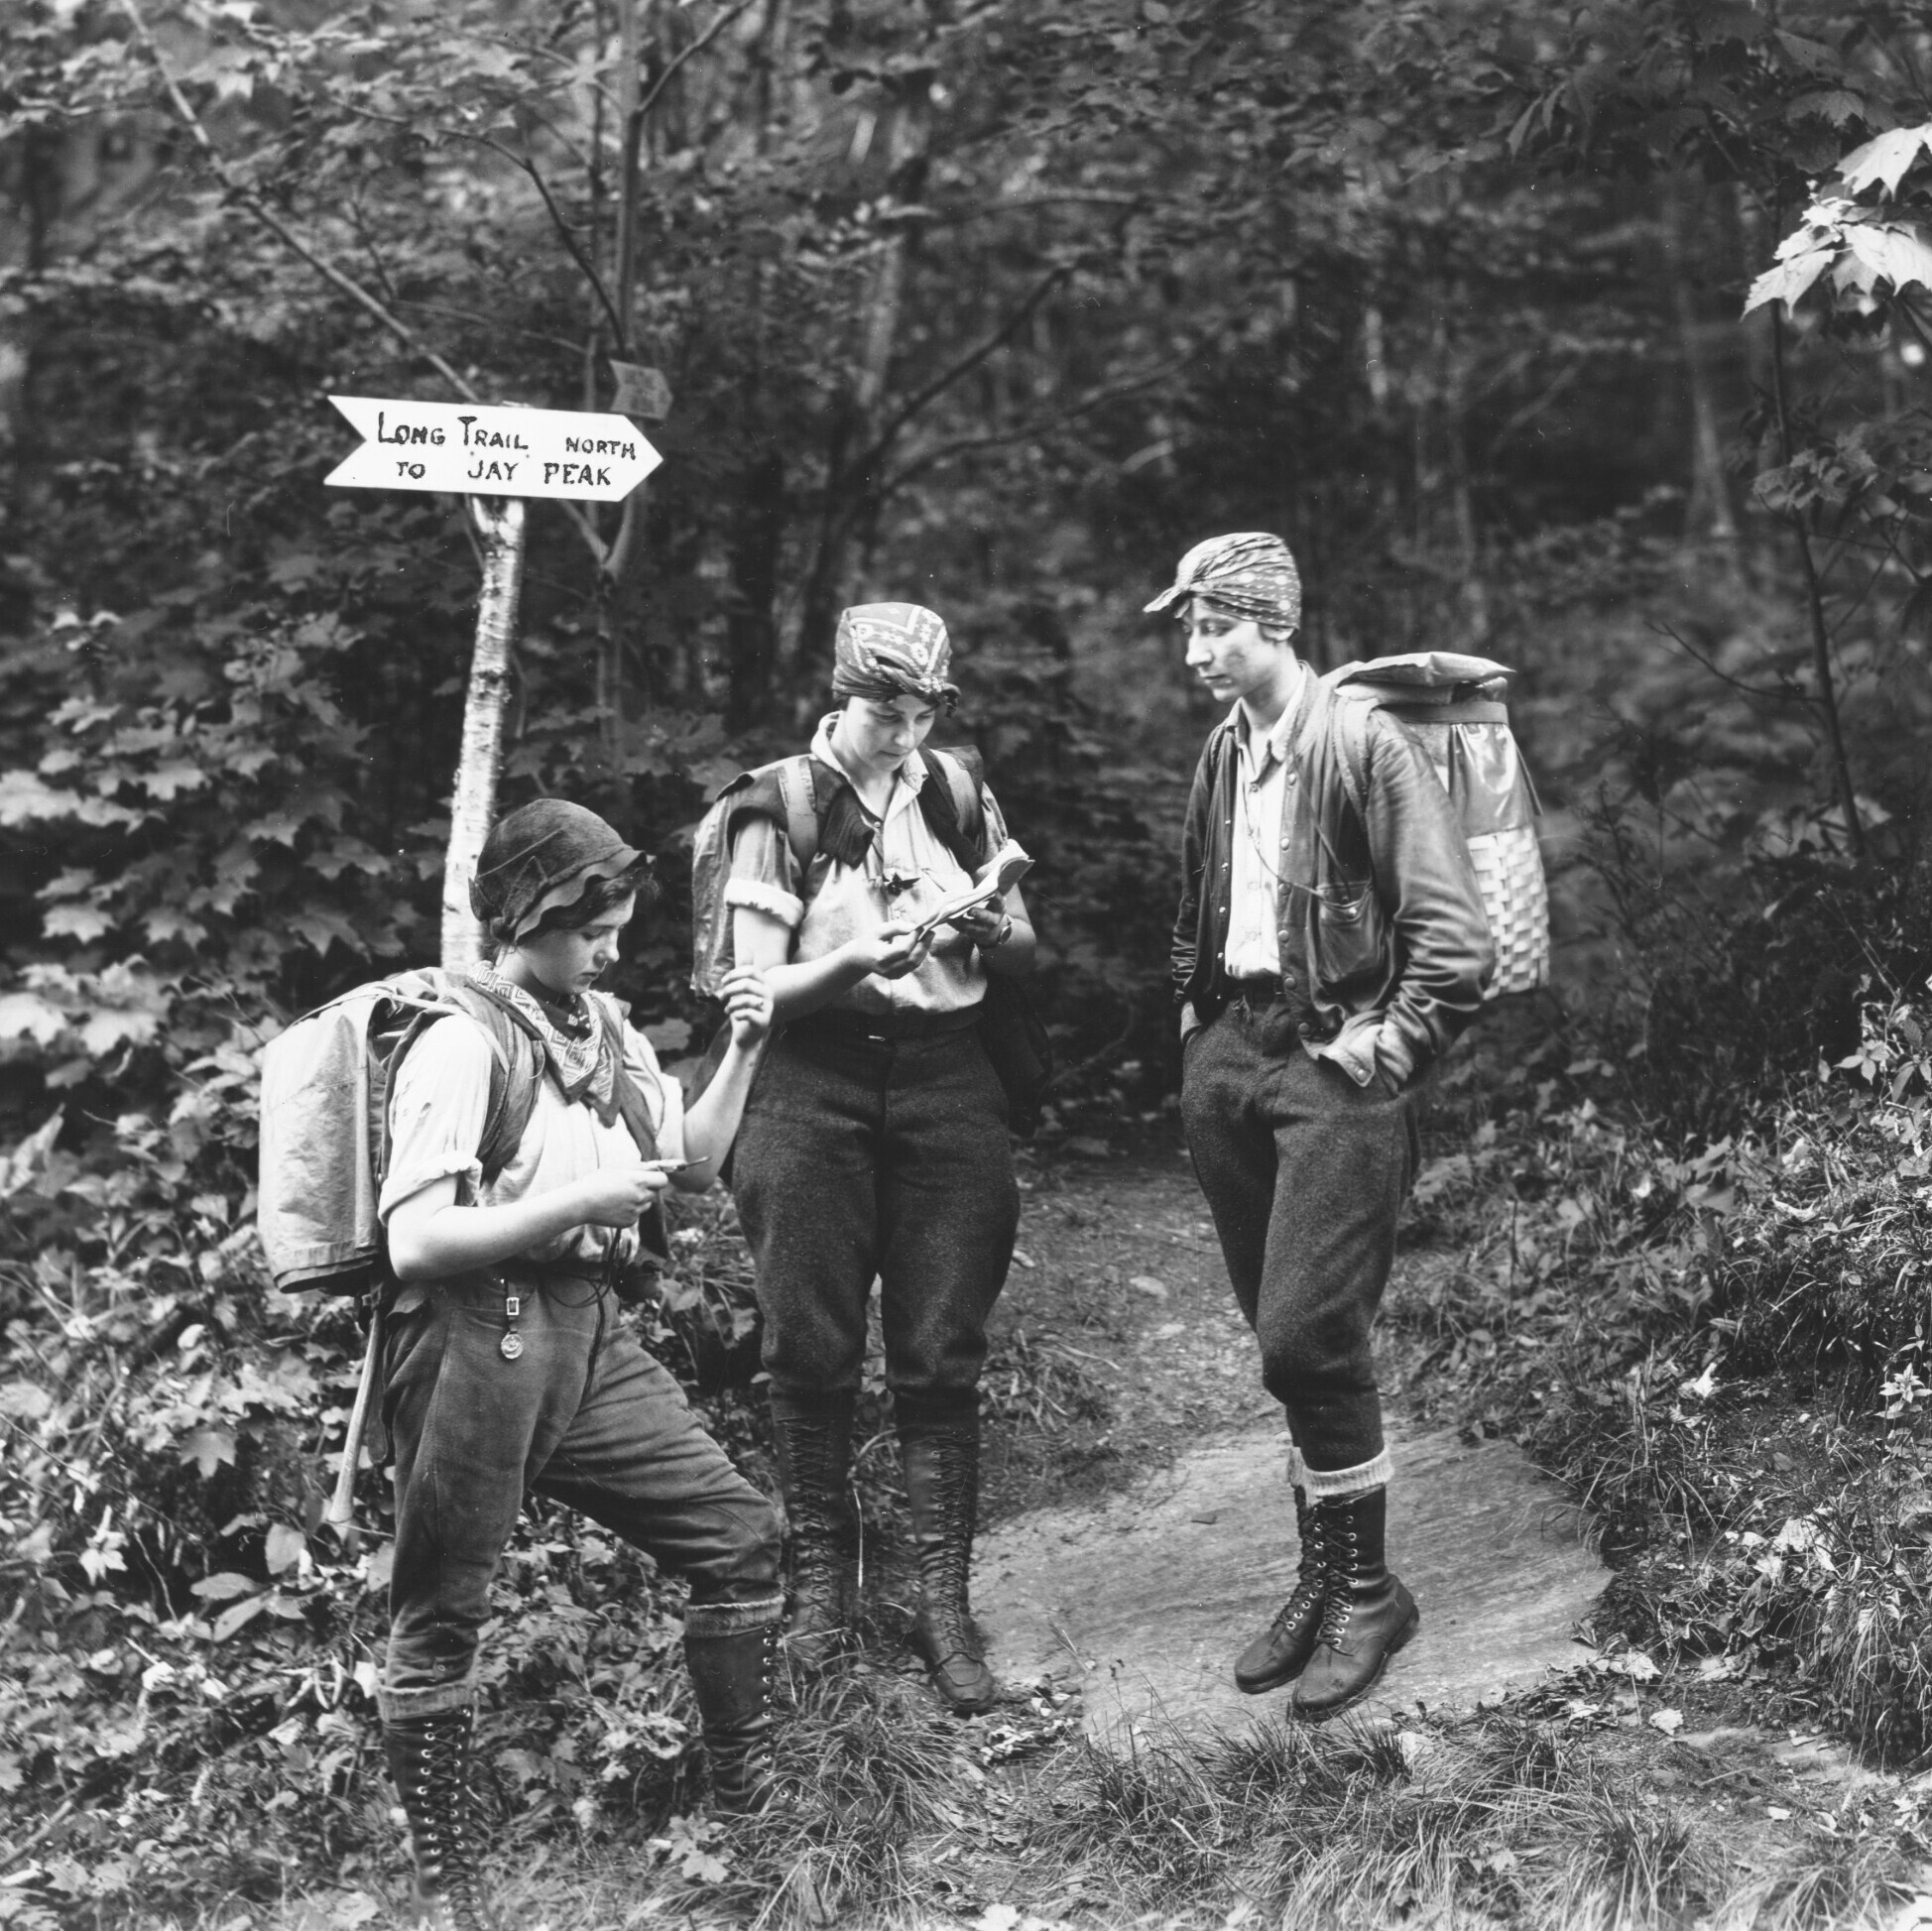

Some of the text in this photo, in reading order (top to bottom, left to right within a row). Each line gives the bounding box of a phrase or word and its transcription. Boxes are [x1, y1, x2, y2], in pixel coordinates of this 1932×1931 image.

[378, 412, 637, 461] LONG TRAIL NORTH
[396, 459, 612, 487] TO JAY PEAK
